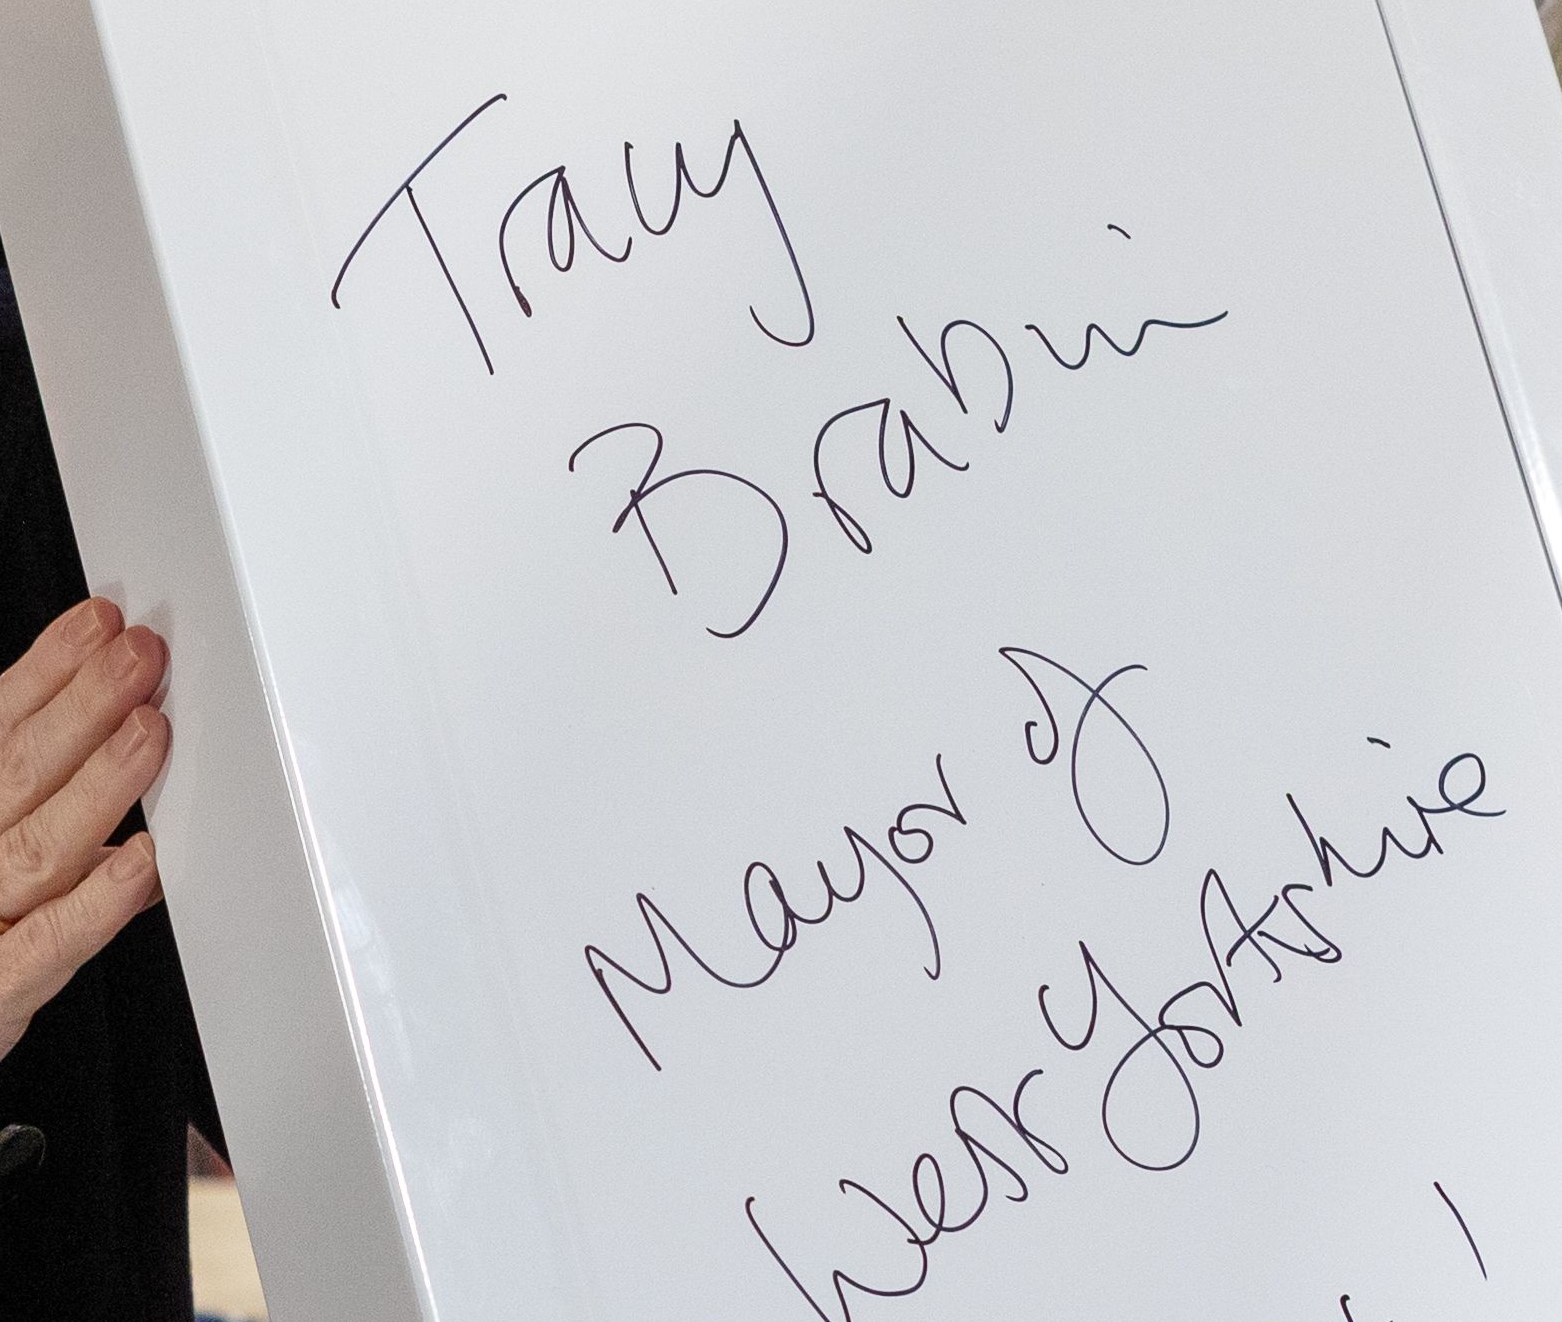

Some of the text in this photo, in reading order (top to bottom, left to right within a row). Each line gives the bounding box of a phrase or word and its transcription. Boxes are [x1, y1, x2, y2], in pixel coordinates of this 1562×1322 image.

[331, 92, 816, 375] Tracy
[568, 222, 1229, 639] Brabin
[584, 646, 1170, 1072] Mayor of
[1039, 735, 1507, 1171] Yorkshire
